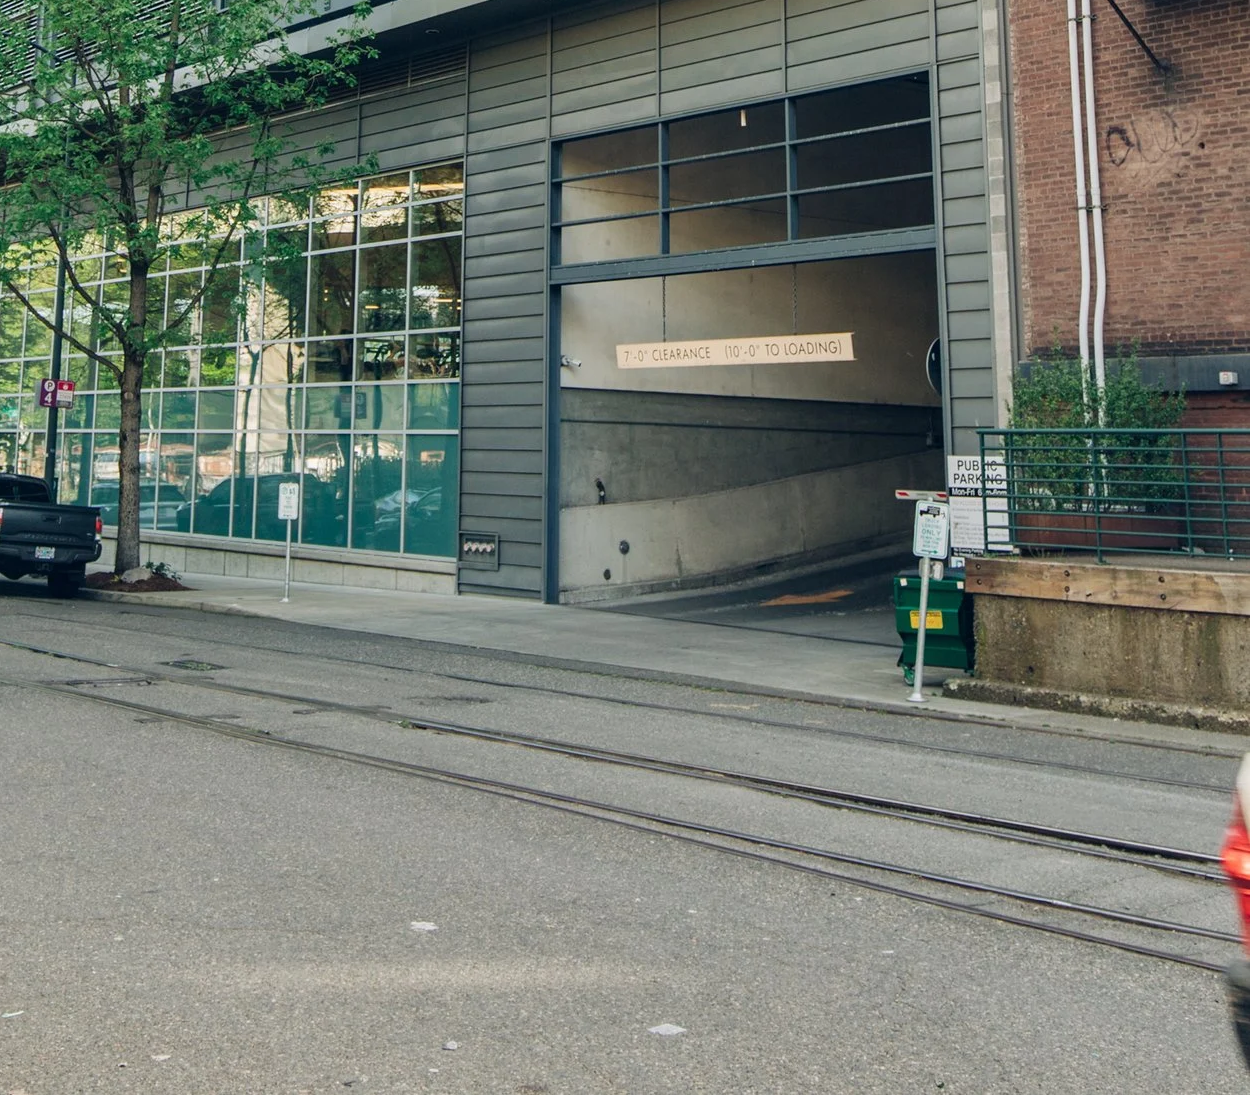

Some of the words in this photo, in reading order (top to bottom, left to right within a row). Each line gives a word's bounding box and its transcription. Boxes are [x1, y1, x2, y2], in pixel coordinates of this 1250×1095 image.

[651, 346, 711, 362] CLEARANCE
[765, 343, 780, 356] TO
[784, 339, 842, 356] LOADING)
[44, 392, 53, 403] 4
[957, 460, 998, 471] PUBIC
[953, 473, 1003, 485] PARKNG
[951, 487, 976, 496] Mon-Fri
[921, 528, 941, 536] ONLY
